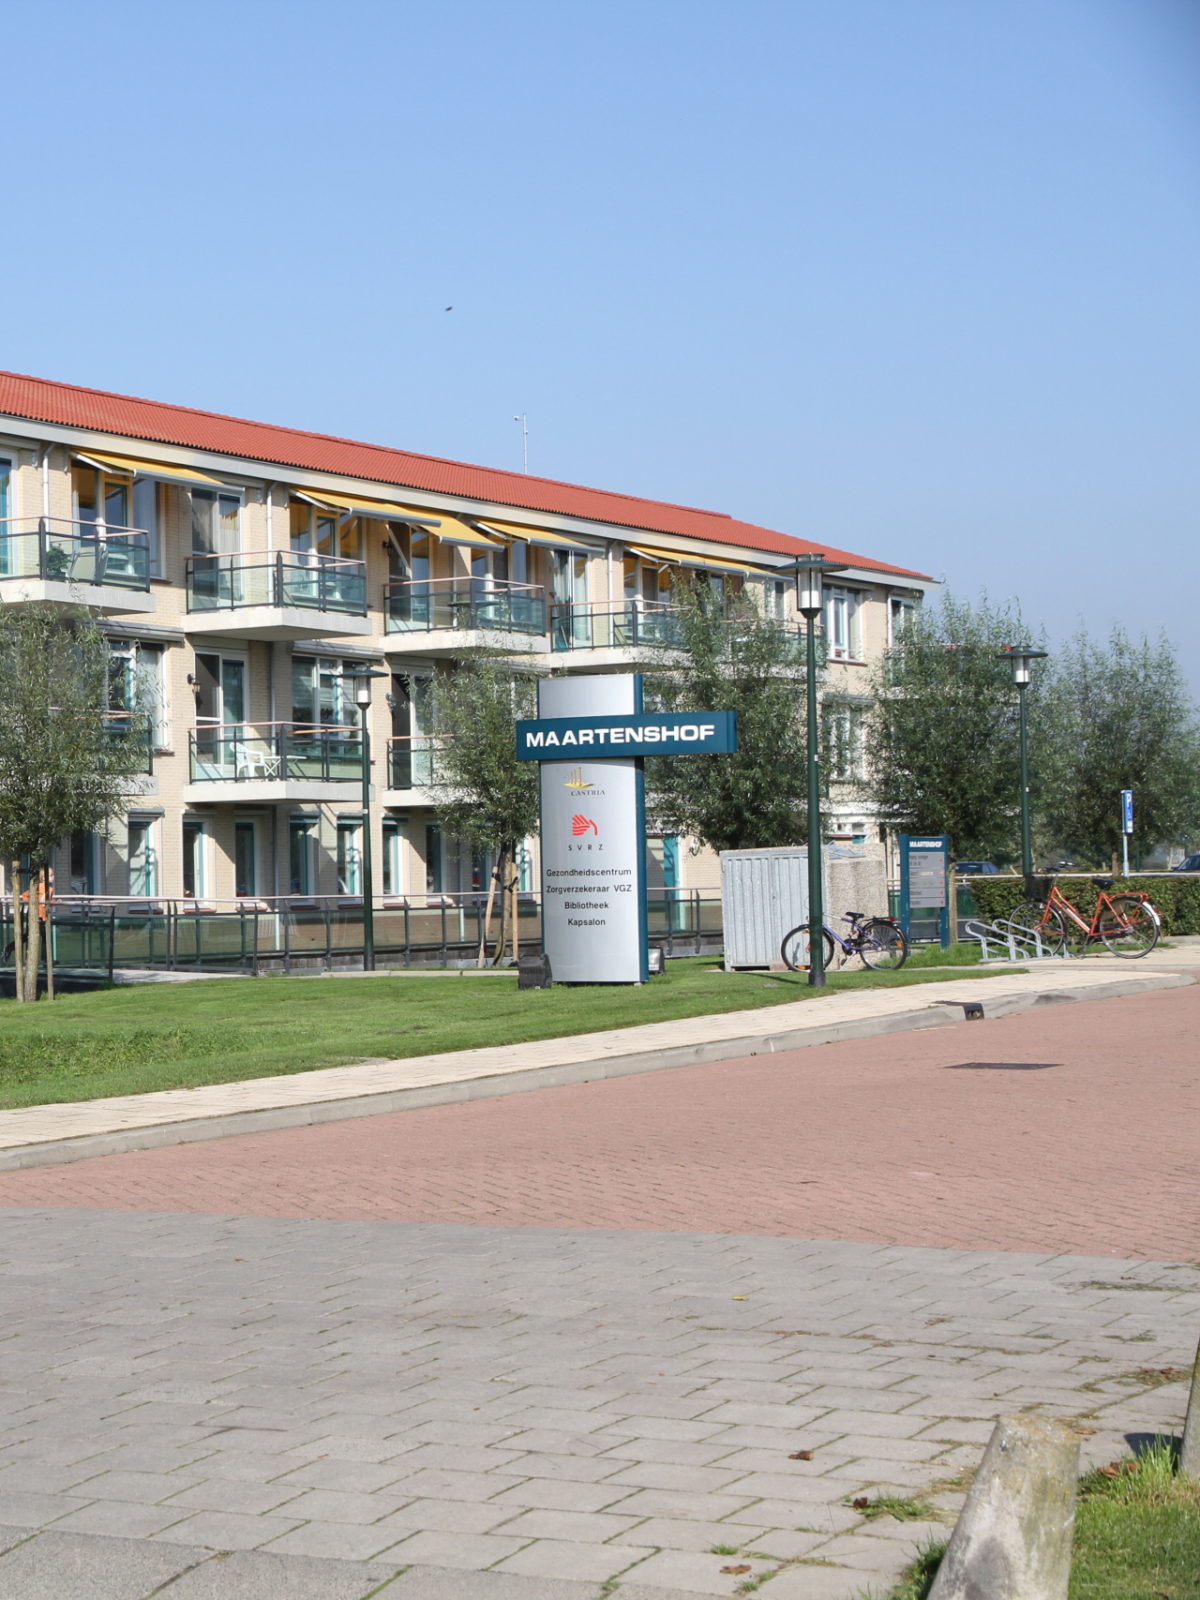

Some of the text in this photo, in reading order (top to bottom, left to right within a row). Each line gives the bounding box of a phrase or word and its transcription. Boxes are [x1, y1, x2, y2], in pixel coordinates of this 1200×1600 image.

[526, 724, 715, 748] MAARTENSHOF
[546, 869, 632, 877] Gezondheidscentrum
[546, 884, 632, 895] Zorgverzekeraar VGZ
[564, 901, 609, 910] Bibliotheek
[567, 918, 606, 927] Kapsalon
